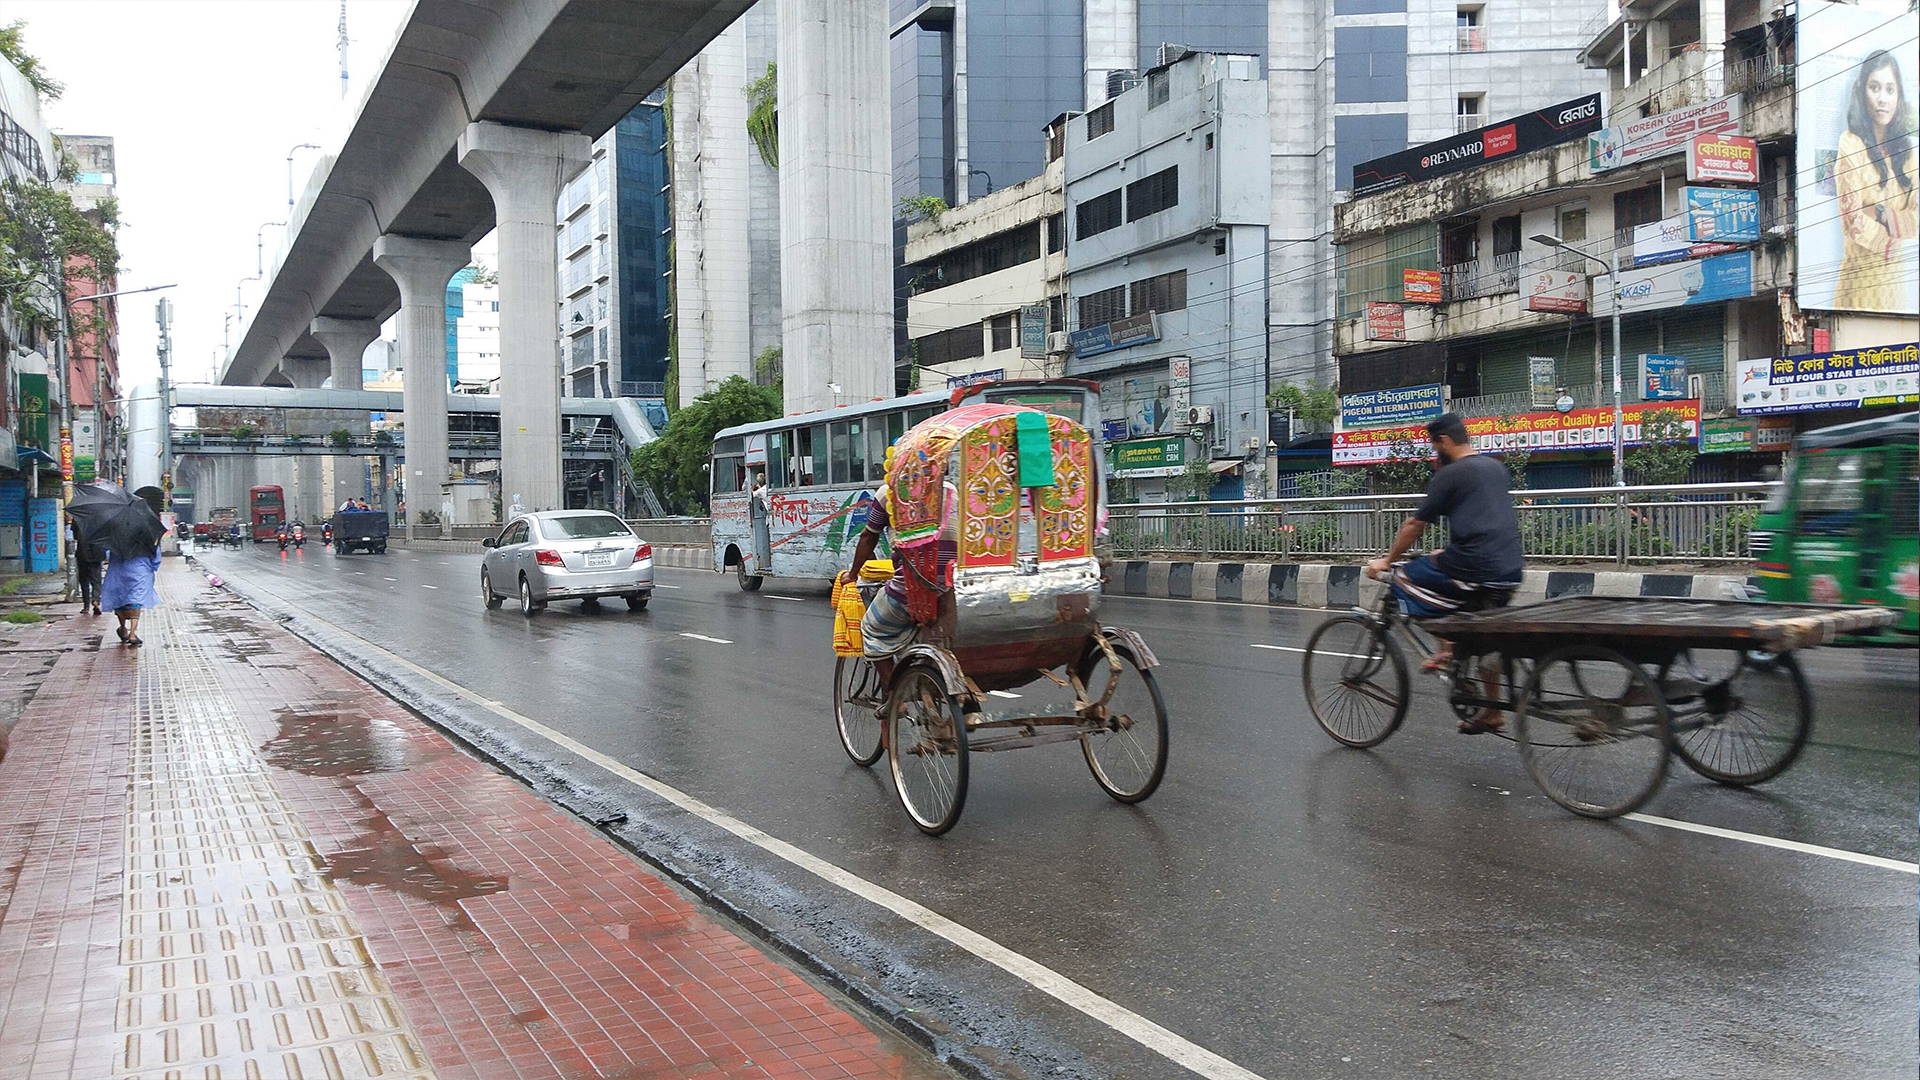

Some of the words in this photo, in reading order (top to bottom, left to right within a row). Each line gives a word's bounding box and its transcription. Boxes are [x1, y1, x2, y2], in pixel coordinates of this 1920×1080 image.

[1558, 98, 1596, 125] রেনার্ড
[1627, 117, 1664, 134] KOREAN
[1666, 106, 1707, 124] CULTURE
[1710, 101, 1728, 113] AID
[1487, 132, 1513, 144] Technology
[1430, 141, 1484, 167] REYNARD
[1697, 140, 1752, 159] কোরিয়ান
[1693, 190, 1722, 200] Customer
[1737, 191, 1752, 200] Point
[1564, 290, 1579, 299] airtel
[1620, 284, 1651, 298] AKASH
[1173, 361, 1189, 377] Safe
[1773, 359, 1795, 375] নিউ
[1797, 357, 1825, 373] ফোর
[1828, 353, 1855, 369] স্টার
[1772, 376, 1794, 385] NEW
[1796, 372, 1824, 382] FOUR
[1825, 368, 1853, 379] STAR
[1343, 394, 1376, 407] পিজিয়ন
[1377, 387, 1439, 404] ইন্টারন্যাশনাল
[1343, 406, 1373, 417] PIGEON
[1374, 399, 1440, 414] INTERNATIONAL
[1533, 414, 1559, 427] ওয়ার্কস
[1563, 413, 1597, 427] Quality
[1348, 432, 1368, 443] মনির
[1166, 443, 1179, 452] ATM
[1166, 453, 1179, 461] CRM
[33, 521, 47, 554] DEW
